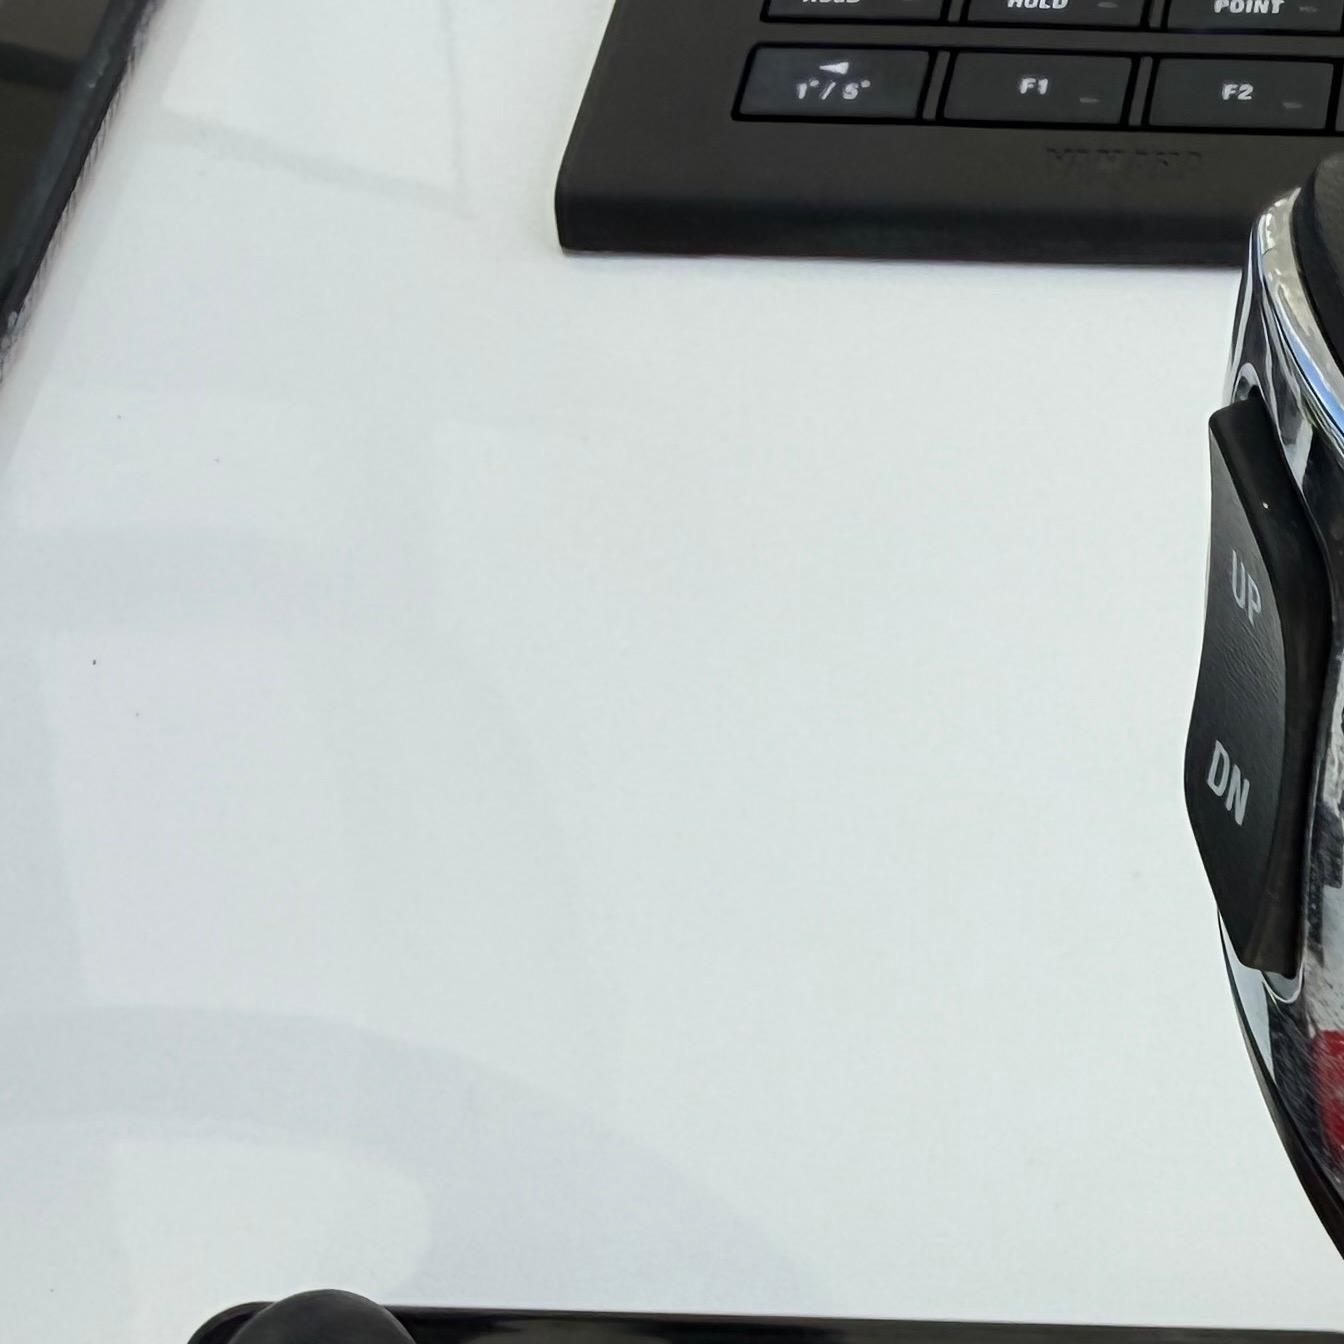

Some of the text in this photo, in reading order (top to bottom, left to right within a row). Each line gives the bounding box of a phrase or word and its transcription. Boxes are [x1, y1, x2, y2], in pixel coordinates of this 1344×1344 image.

[1214, 0, 1286, 14] POINT
[1019, 77, 1049, 95] F1
[1221, 83, 1254, 101] F2
[1232, 549, 1262, 626] UP
[1206, 740, 1250, 826] DN
